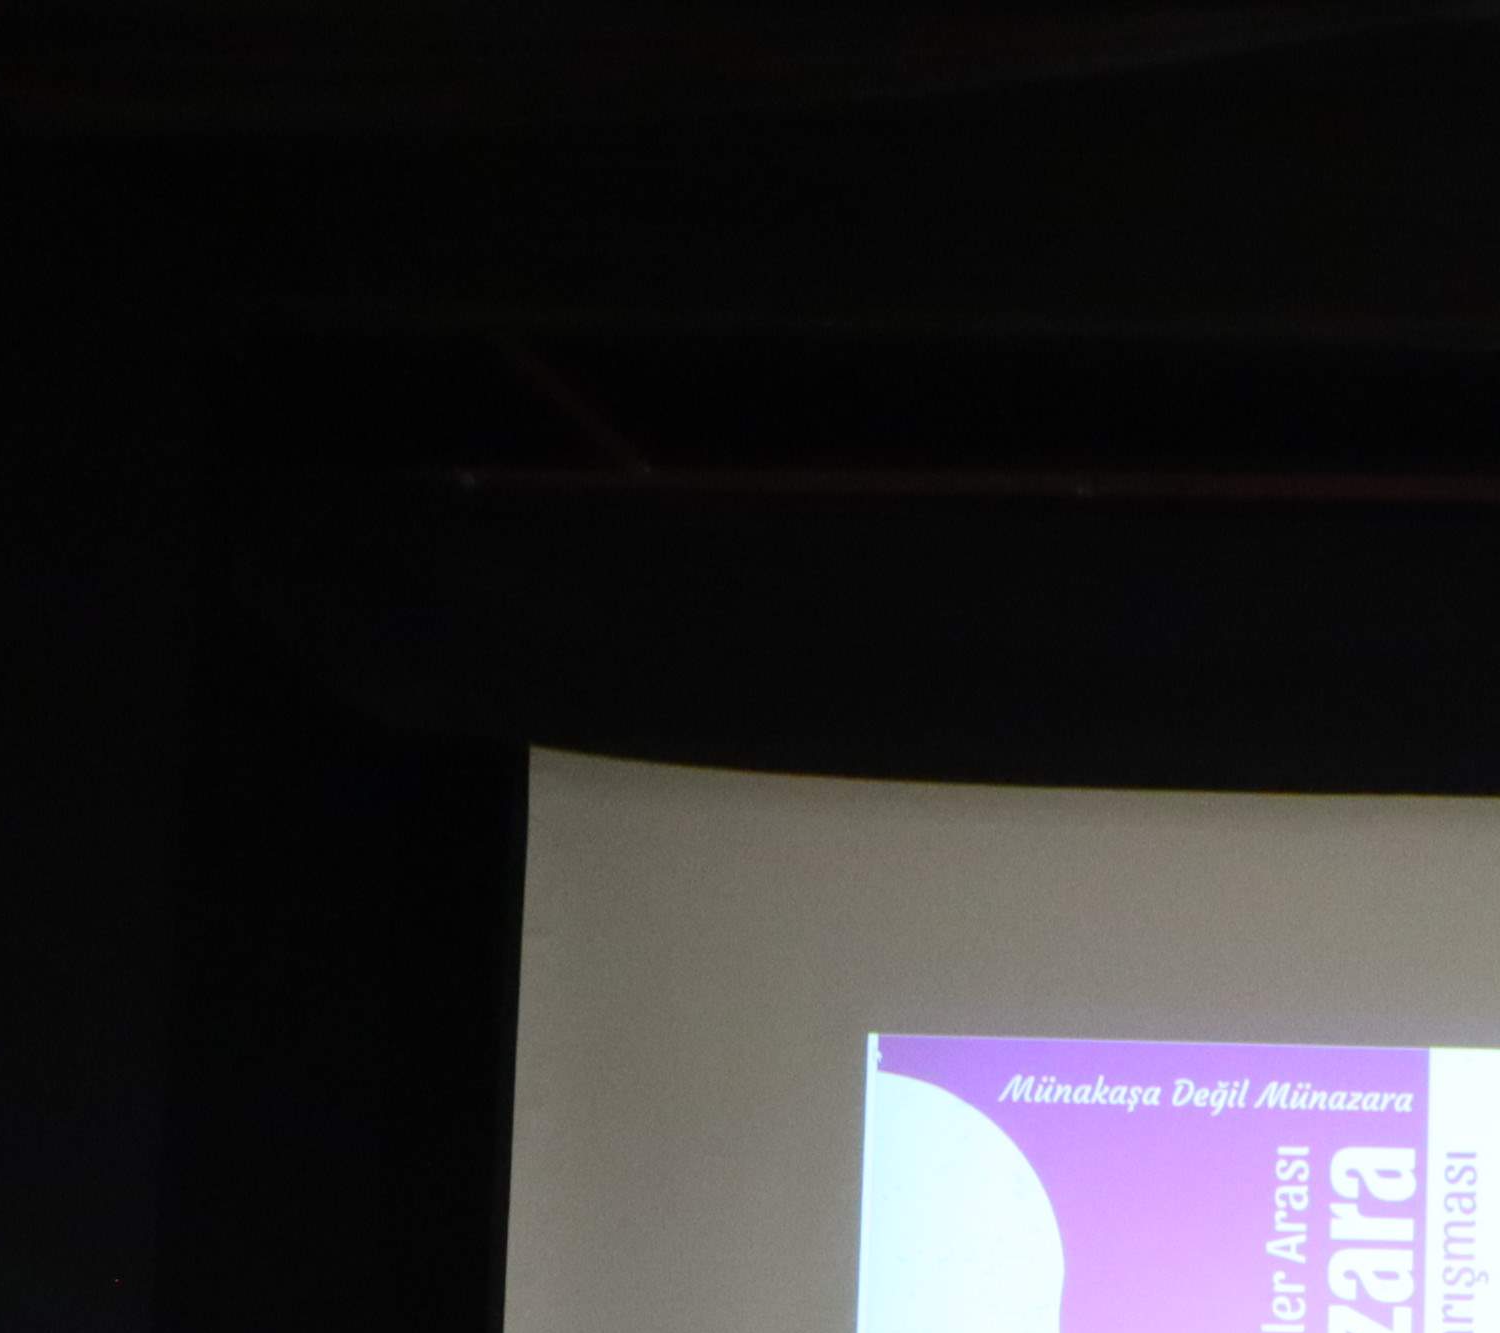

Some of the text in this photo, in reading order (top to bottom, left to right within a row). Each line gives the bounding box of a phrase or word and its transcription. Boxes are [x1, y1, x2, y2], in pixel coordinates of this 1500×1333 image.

[998, 1074, 1413, 1116] Münakaşa Değil Münazara
[1266, 1146, 1310, 1264] Arası
